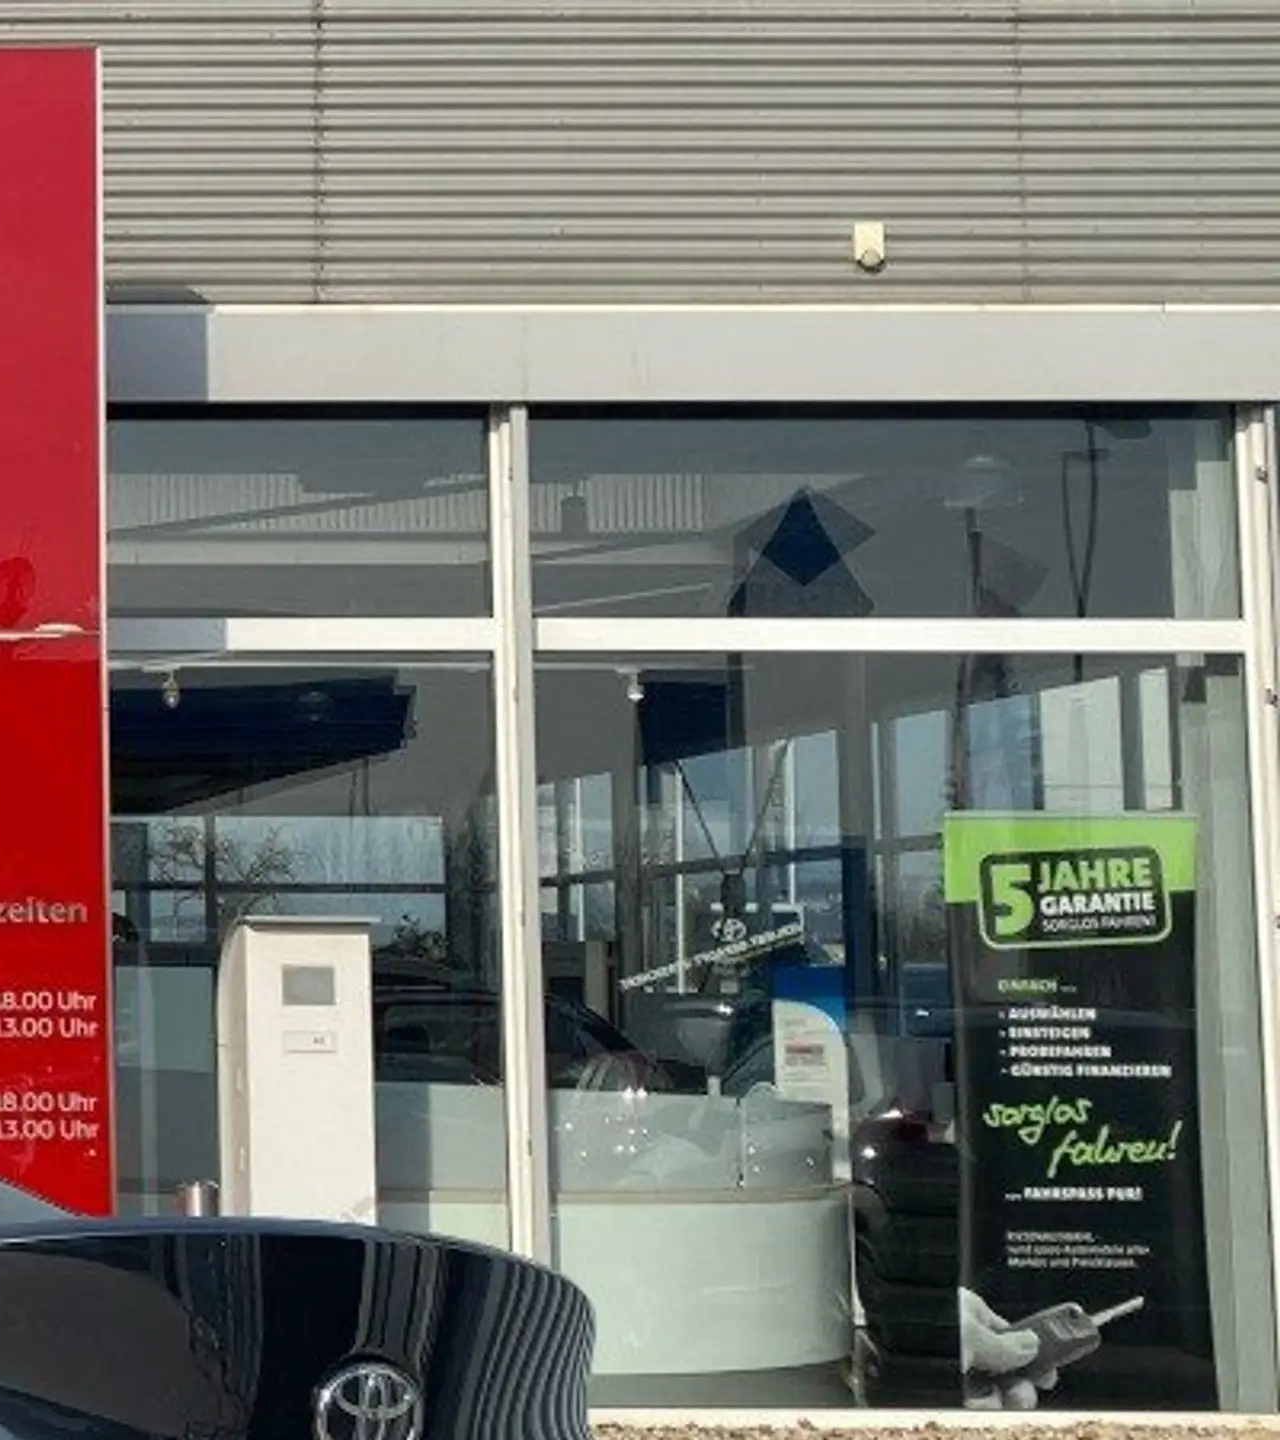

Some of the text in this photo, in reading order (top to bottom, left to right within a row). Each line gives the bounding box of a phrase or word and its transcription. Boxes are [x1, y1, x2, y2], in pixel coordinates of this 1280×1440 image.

[1039, 858, 1152, 891] JAHRE
[991, 864, 1034, 935] 5
[1040, 892, 1155, 917] GARANTIE
[57, 990, 97, 1011] Uhr
[59, 1017, 99, 1038] Uhr
[57, 1091, 97, 1112] Uhr
[60, 1119, 99, 1140] Uhr
